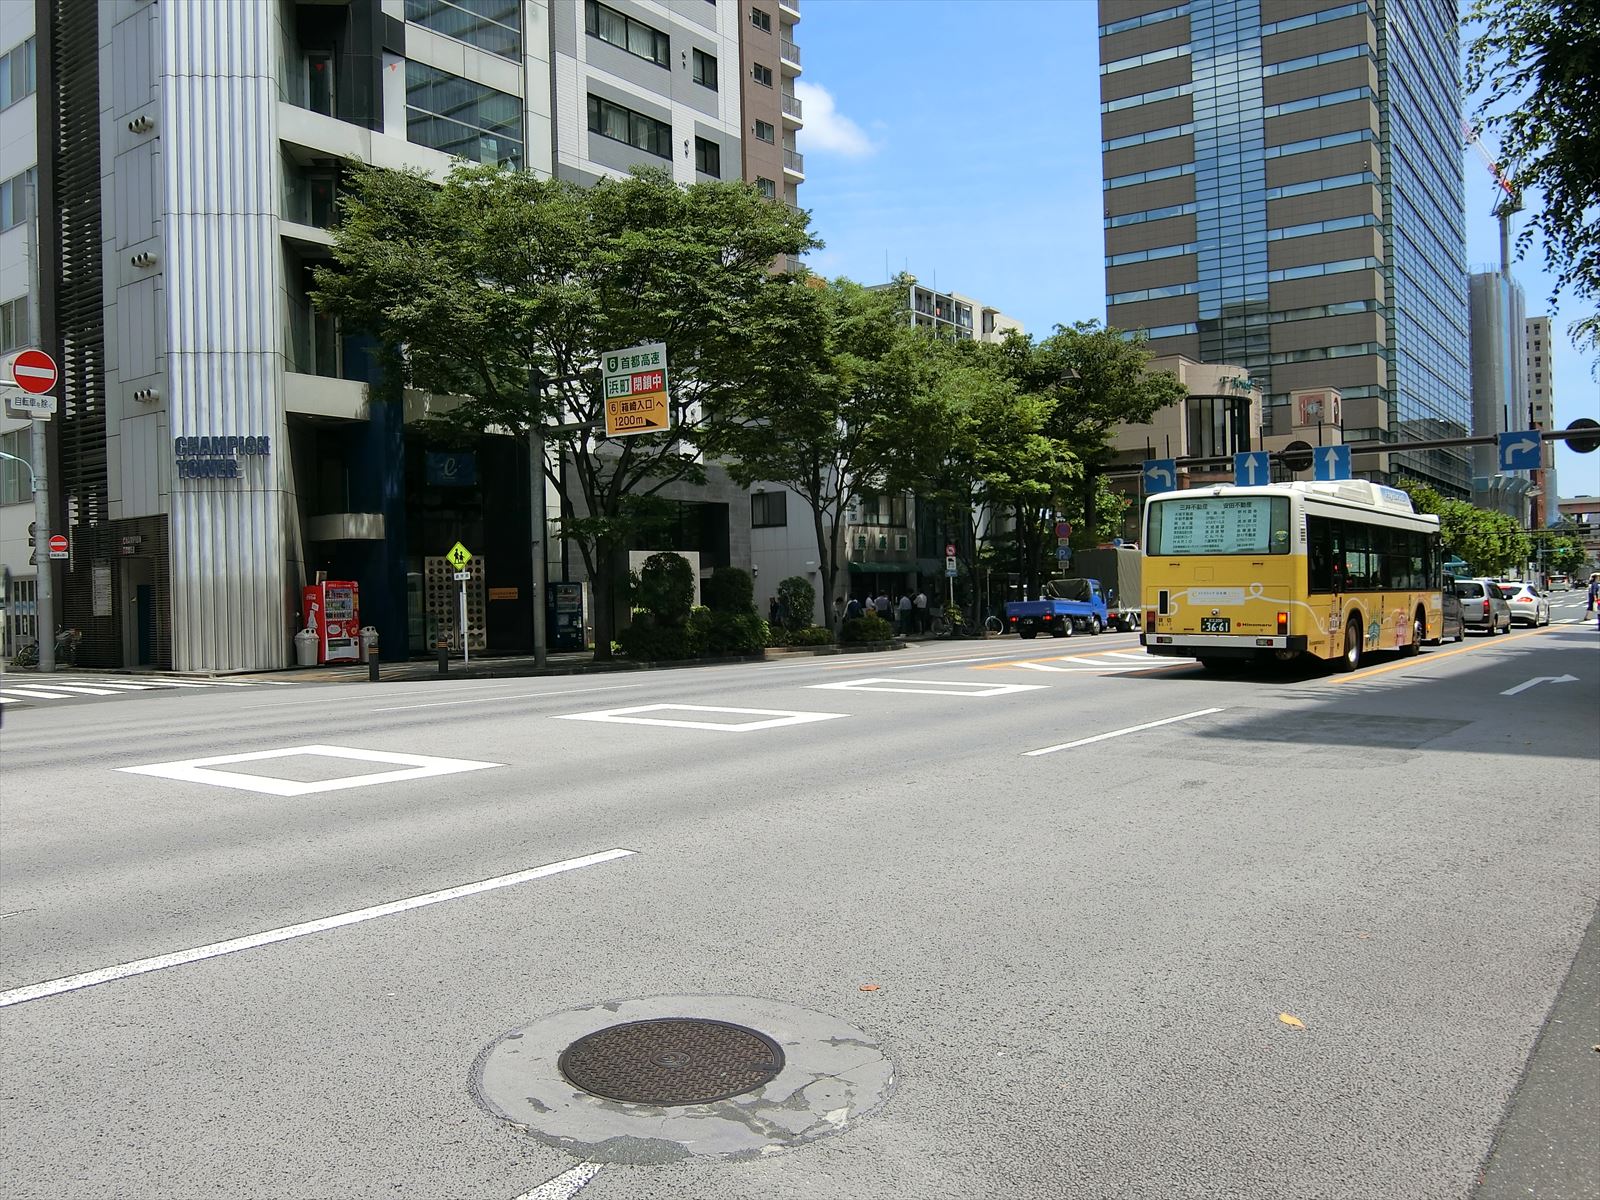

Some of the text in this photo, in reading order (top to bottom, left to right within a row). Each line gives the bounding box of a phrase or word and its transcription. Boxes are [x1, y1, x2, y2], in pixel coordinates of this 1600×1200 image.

[620, 351, 660, 370] 首都高速
[609, 374, 662, 395] 浜町 閉鎖中
[15, 396, 53, 409] 自転車を除く
[614, 415, 643, 427] 1200m
[174, 435, 271, 456] CHAMPION
[175, 459, 245, 480] TOWER
[1223, 501, 1252, 509] 安田不動産
